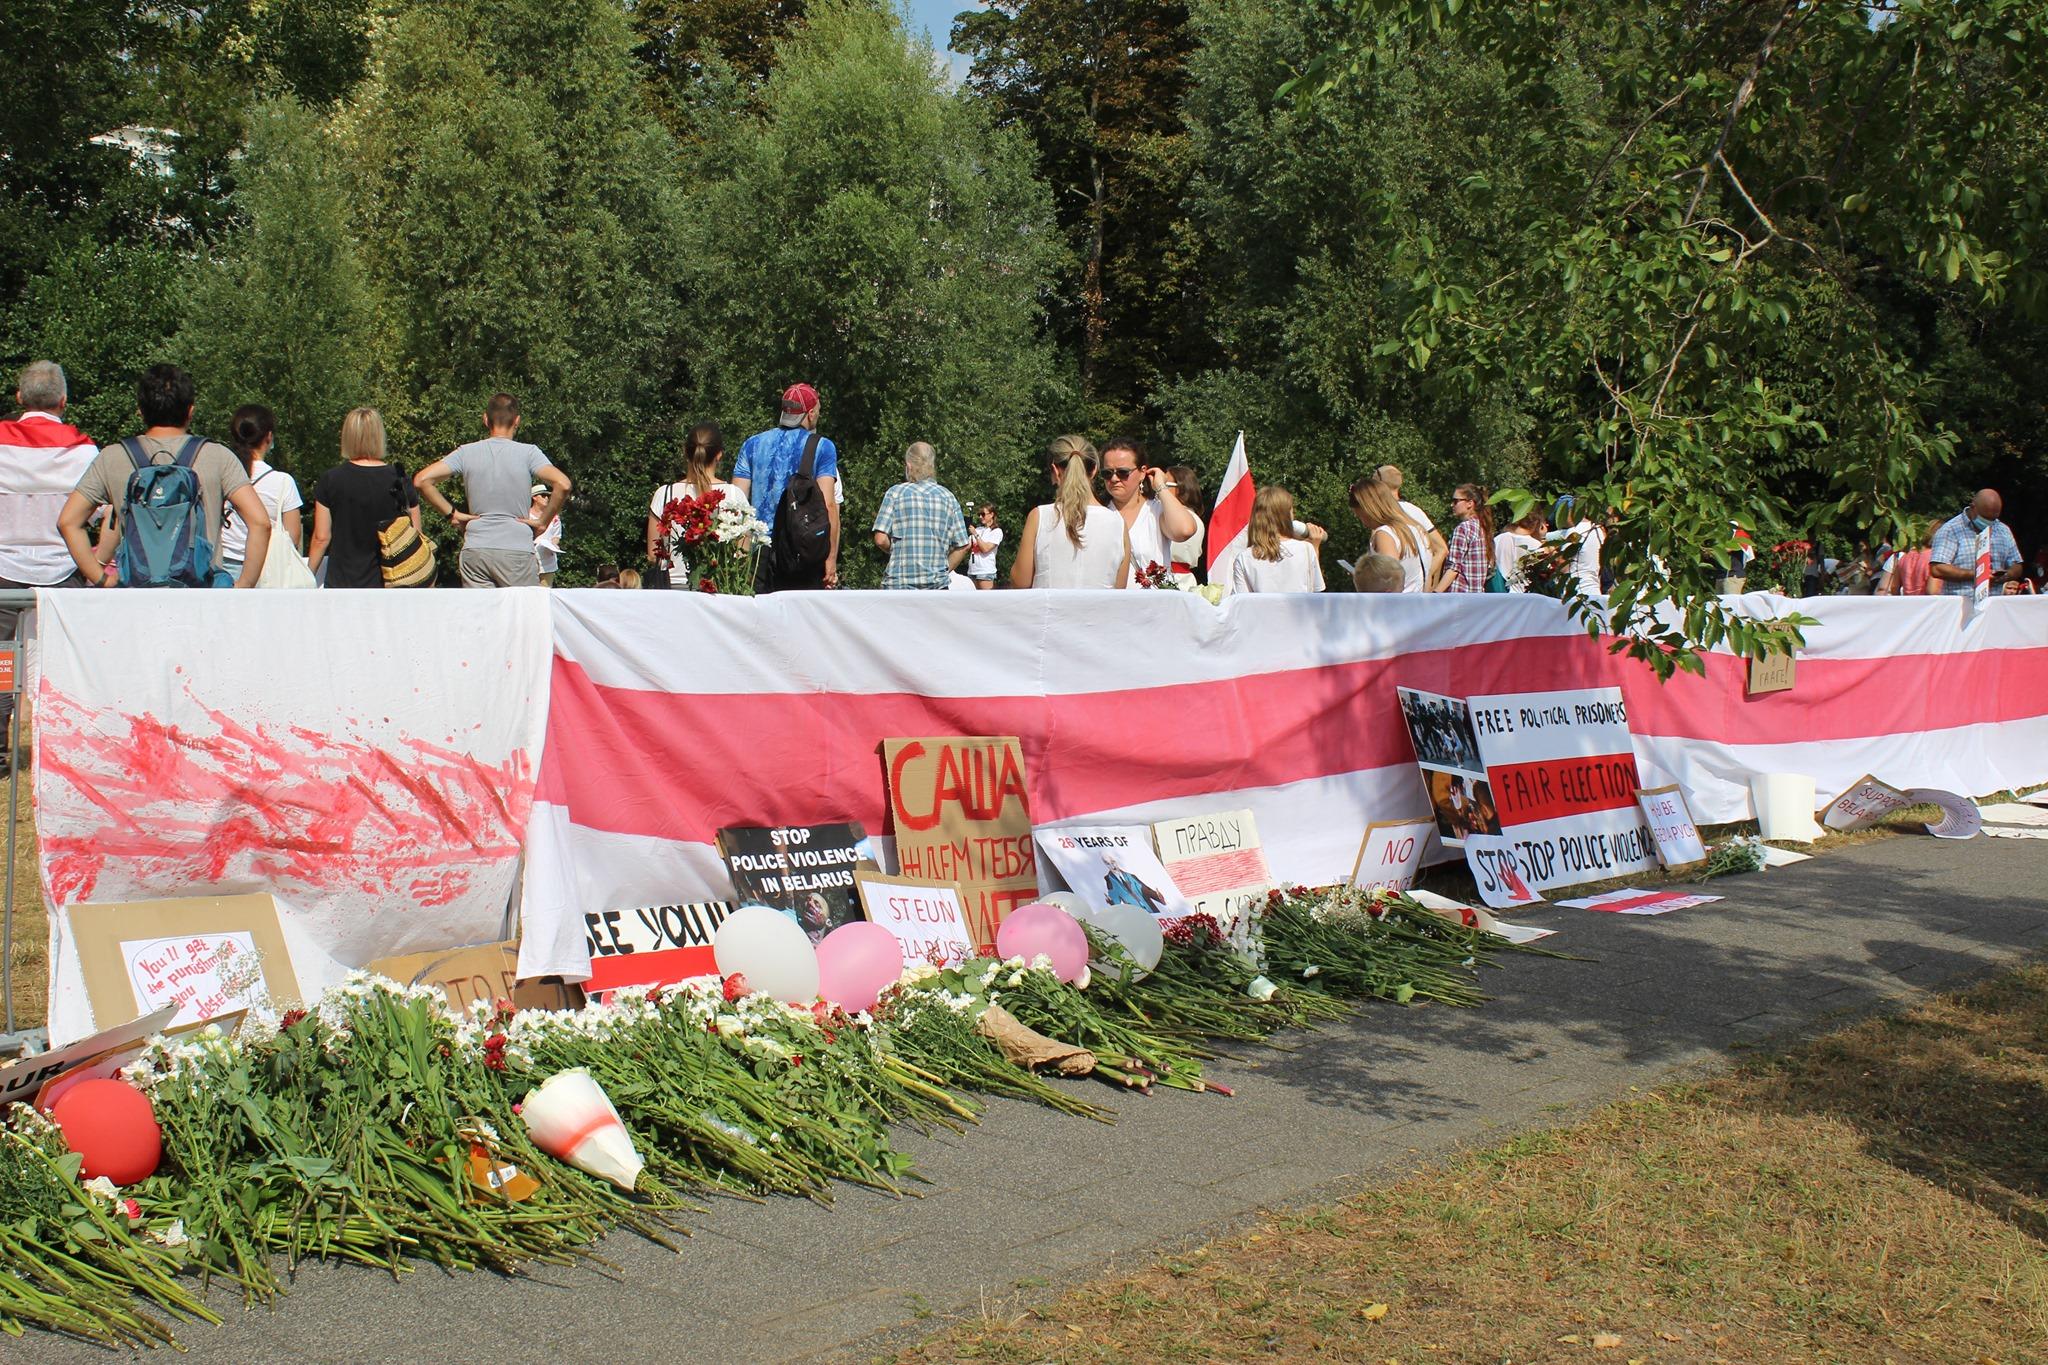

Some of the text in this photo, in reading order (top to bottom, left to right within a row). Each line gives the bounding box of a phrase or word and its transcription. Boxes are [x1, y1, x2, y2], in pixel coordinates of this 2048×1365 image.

[1475, 701, 1628, 736] FREE POLITICAL PRISONERS
[891, 741, 1031, 831] САША
[1502, 761, 1640, 812] FAIR ELECTION
[770, 828, 811, 846] STOP
[1058, 836, 1129, 849] 26 YEARS OF
[1175, 819, 1242, 854] ПРАВДУ
[1381, 837, 1415, 866] NO
[730, 847, 868, 871] POLICE VIOLENCE
[973, 834, 1038, 881] ТЕБЯ
[1559, 834, 1611, 872] POLICE
[761, 870, 854, 893] IN BELARUS
[889, 896, 956, 923] STEUN
[186, 938, 211, 961] get
[147, 940, 239, 995] the punishmt
[170, 985, 196, 1010] you
[0, 1060, 65, 1093] UR
